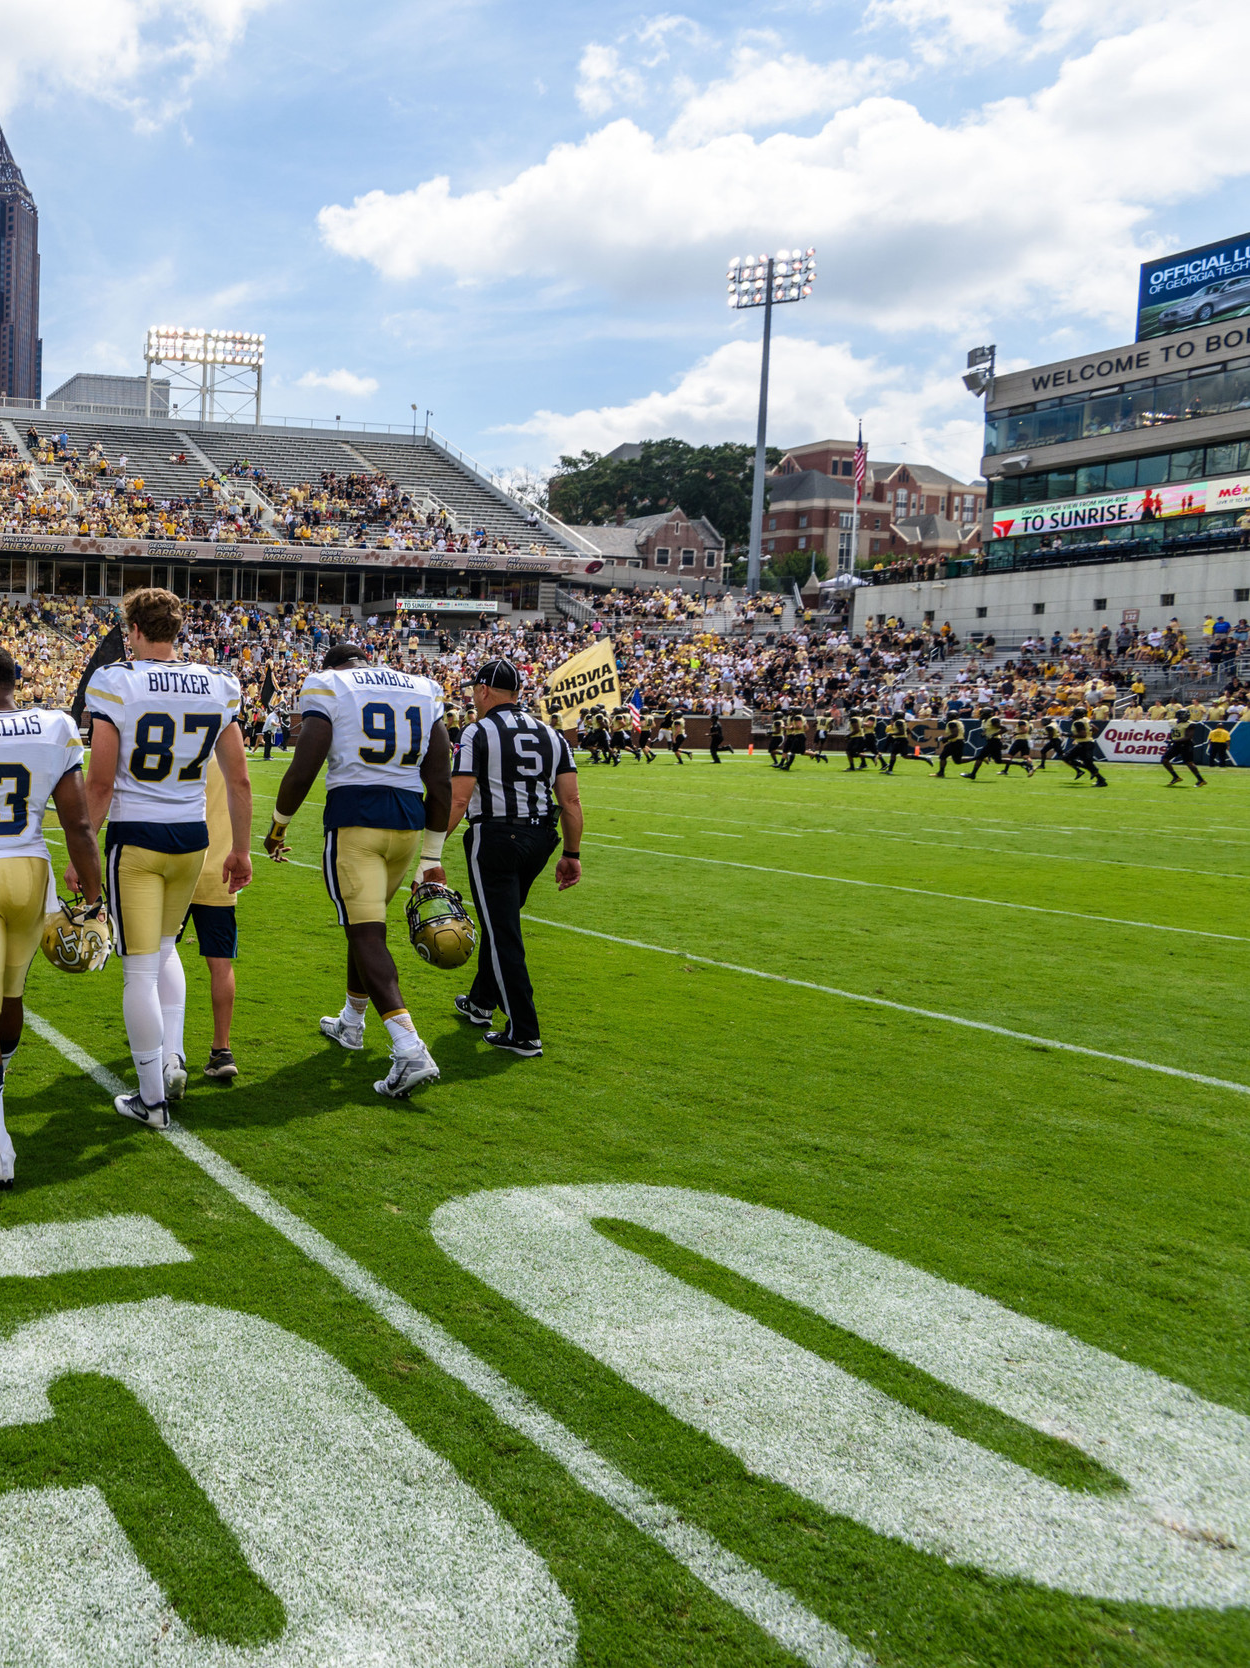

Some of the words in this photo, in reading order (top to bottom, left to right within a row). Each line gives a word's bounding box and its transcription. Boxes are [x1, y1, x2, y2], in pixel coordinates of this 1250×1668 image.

[1150, 253, 1231, 285] OFFICIAL
[1149, 282, 1165, 295] OF
[1165, 269, 1215, 290] GEORGIA
[1032, 351, 1150, 391] WELCOME
[1160, 341, 1195, 362] TO
[1021, 515, 1044, 532] TO
[1050, 504, 1134, 529] SUNRISE.
[2, 542, 65, 552] ALEXANDER
[148, 549, 197, 557] GARDNER
[214, 551, 244, 559] DODD
[263, 553, 301, 561] MORRIS
[319, 555, 358, 563] GASTON
[506, 562, 551, 570] SWILLING
[147, 672, 211, 695] BUTKER
[352, 671, 414, 689] GAMBLE
[359, 702, 422, 766] 91
[129, 712, 222, 783] 87
[513, 733, 543, 777] S
